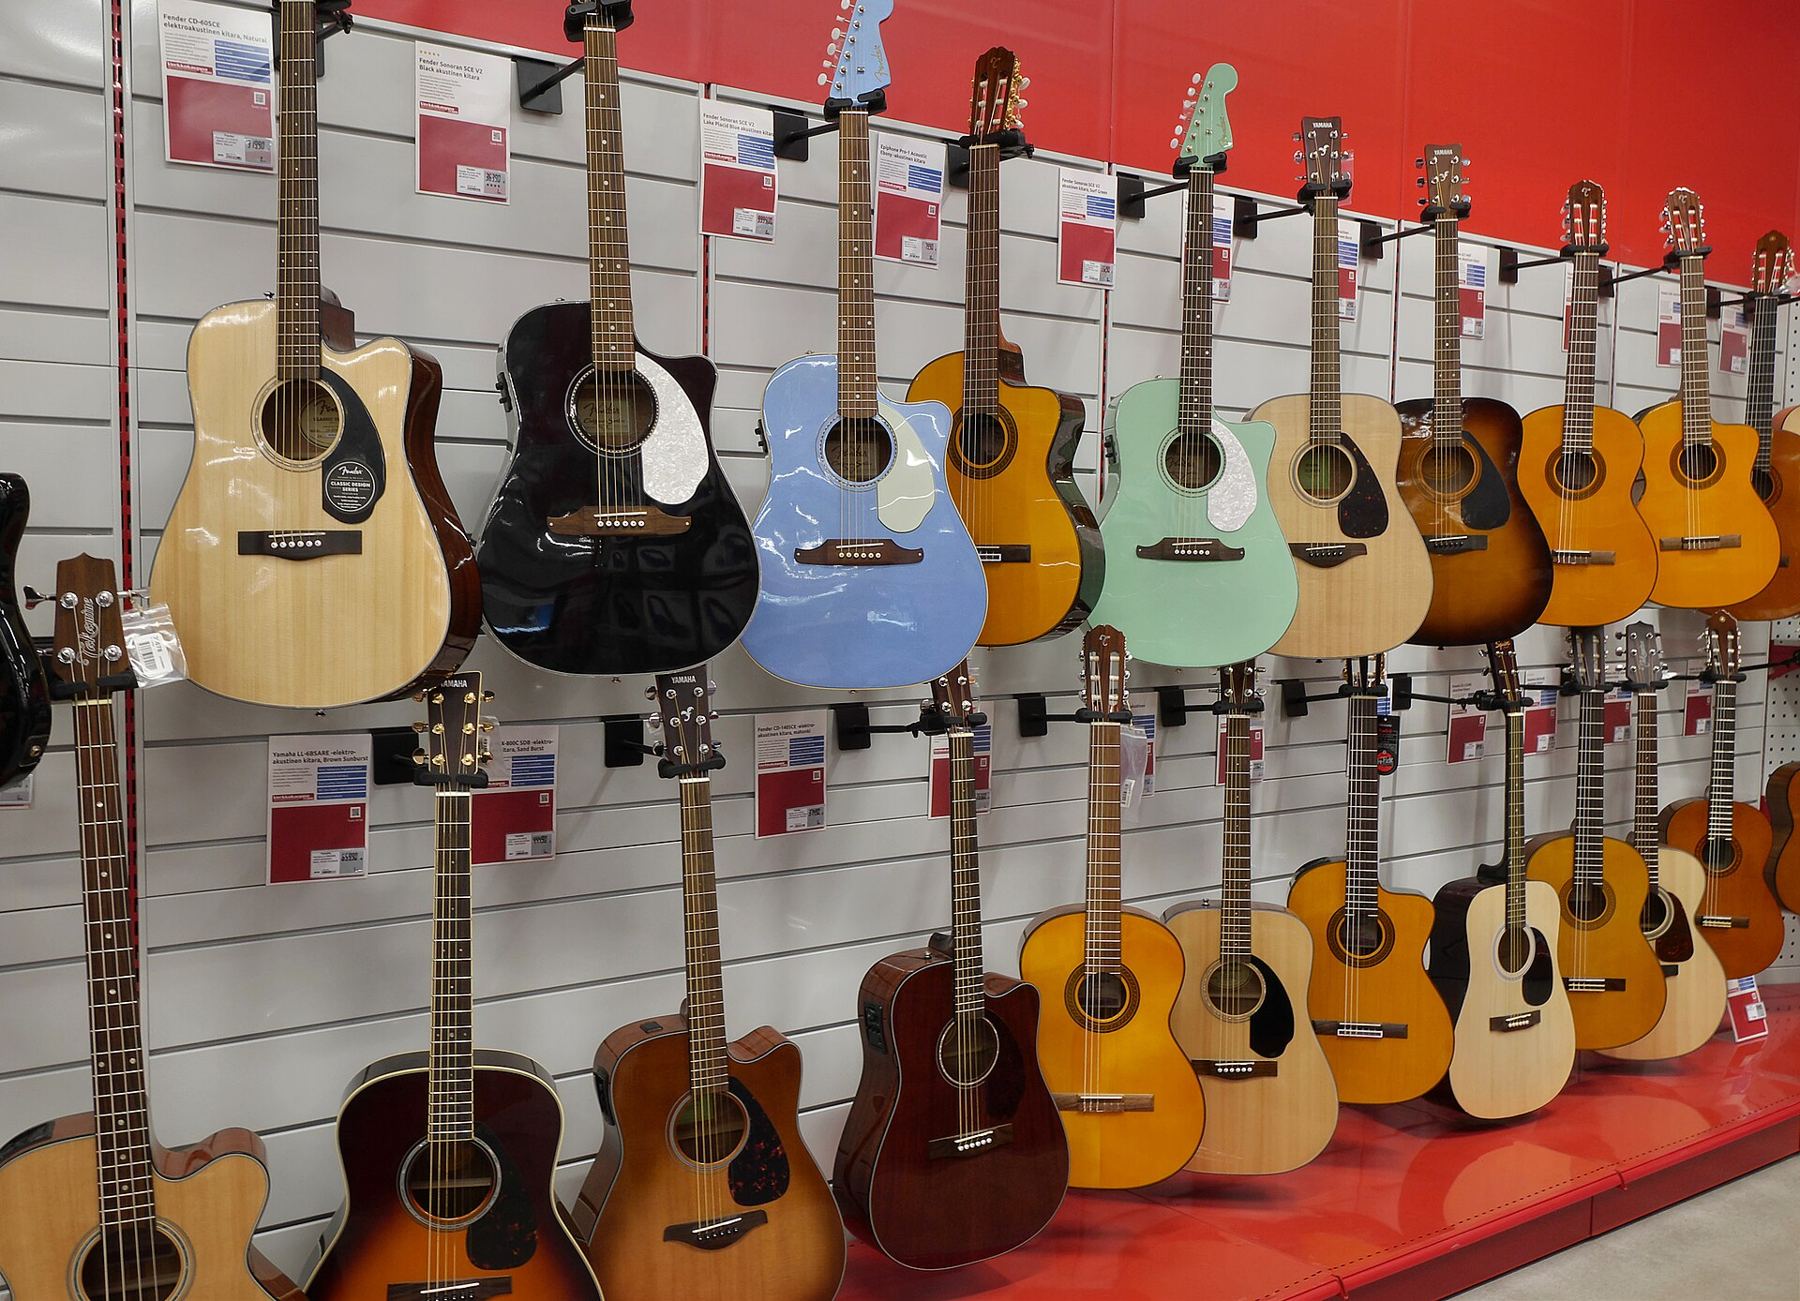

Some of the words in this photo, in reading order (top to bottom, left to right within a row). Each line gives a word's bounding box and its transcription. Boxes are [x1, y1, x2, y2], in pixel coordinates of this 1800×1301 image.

[163, 13, 187, 22] Fender
[163, 21, 220, 35] elektroakustinen
[420, 58, 439, 66] Fender
[440, 61, 462, 71] Sonoran
[436, 68, 462, 77] akustinen
[464, 72, 480, 80] kitara
[338, 466, 363, 476] Fender
[671, 675, 697, 684] YAMAHA
